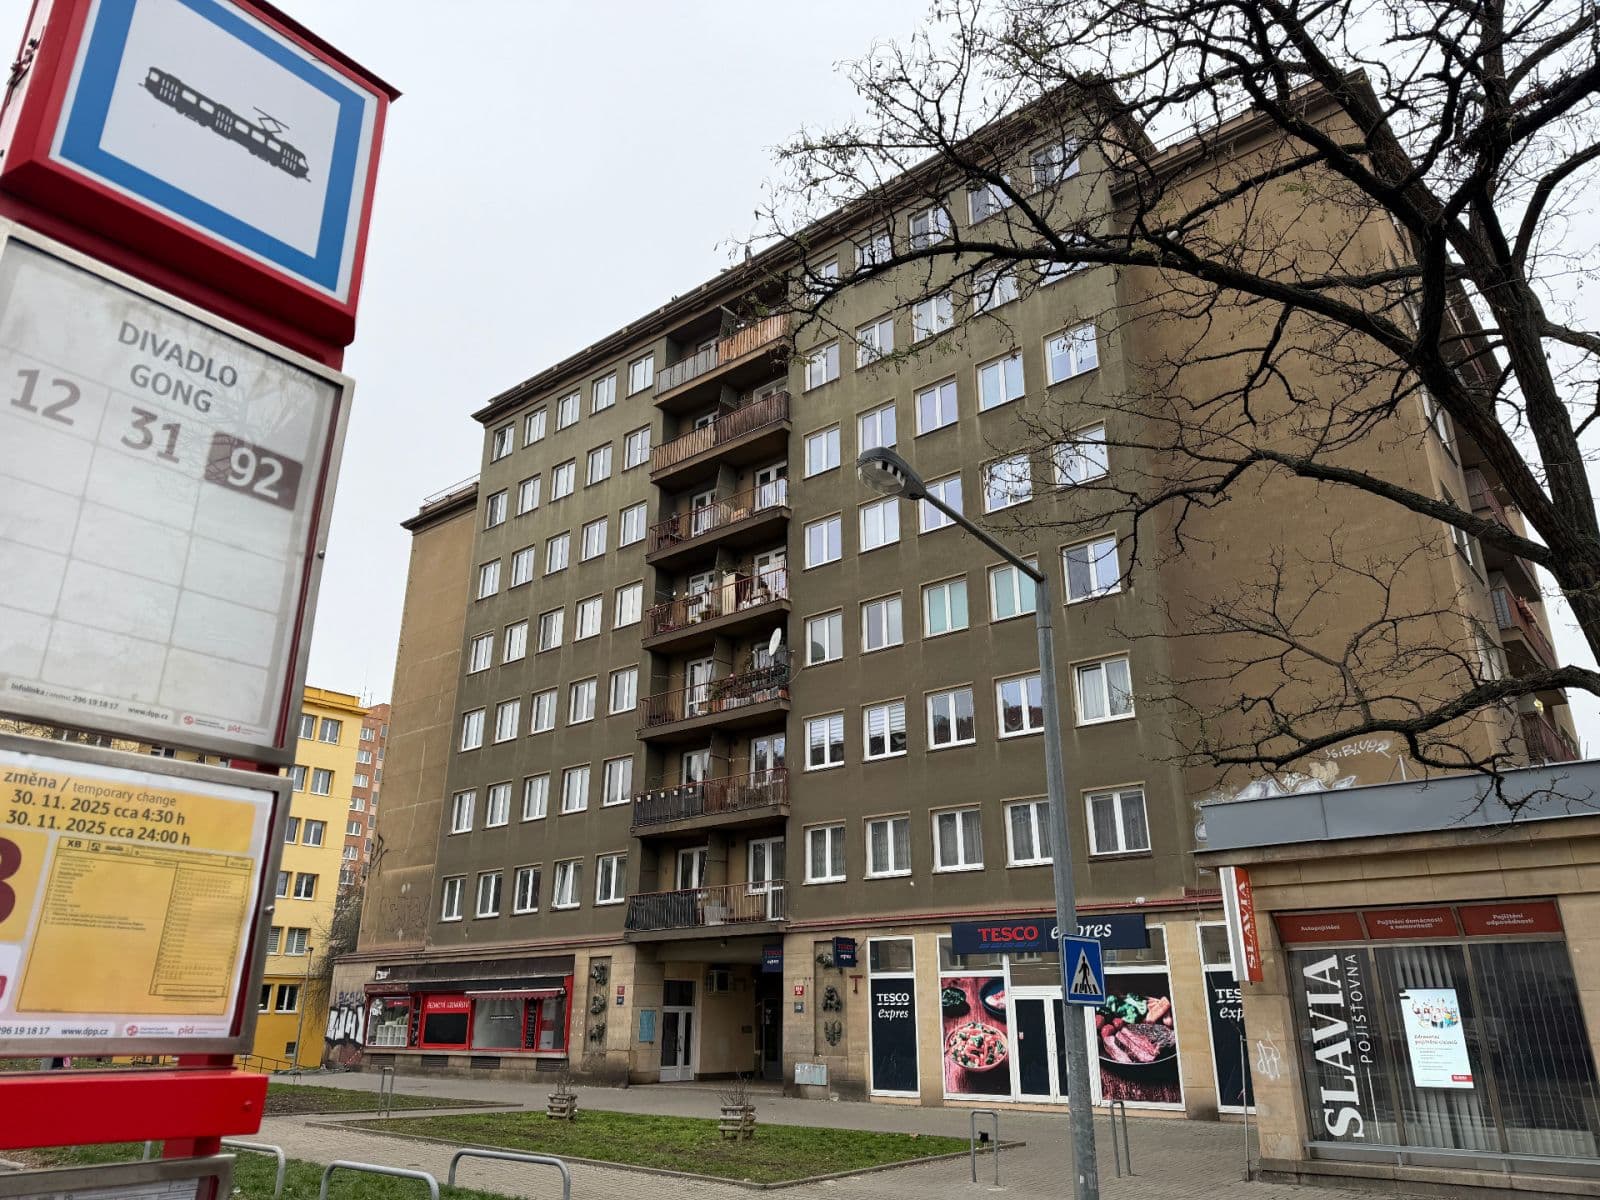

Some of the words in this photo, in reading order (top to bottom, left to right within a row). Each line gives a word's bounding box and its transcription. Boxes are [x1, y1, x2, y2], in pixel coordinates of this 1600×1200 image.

[117, 320, 238, 388] DIVADLO
[10, 369, 81, 426] 12
[130, 363, 214, 413] GONG
[121, 405, 183, 464] 31
[228, 446, 284, 500] 92
[73, 695, 87, 704] 296
[88, 698, 97, 706] 19
[110, 702, 119, 710] 17
[4, 771, 57, 790] změna
[60, 777, 70, 792] /
[73, 782, 134, 802] temporary
[136, 791, 177, 808] change
[11, 789, 36, 806] 30.
[42, 794, 65, 810] 11.
[70, 797, 111, 816] 2025
[114, 806, 138, 820] cca
[142, 807, 174, 824] 4:30
[176, 812, 186, 826] h
[6, 809, 31, 826] 30.
[36, 814, 61, 830] 11.
[65, 817, 106, 835] 2025
[109, 825, 135, 839] cca
[137, 827, 179, 844] 24:00
[181, 832, 191, 845] h
[977, 925, 1038, 943] TESCO
[1239, 881, 1256, 969] SLAVIA
[876, 992, 910, 1002] TESCO
[1215, 988, 1242, 999] TES
[1345, 954, 1374, 1064] POJIŠŤOVNA
[0, 1027, 13, 1035] 96
[14, 1027, 25, 1035] 19
[27, 1027, 37, 1035] 18
[39, 1027, 50, 1035] 17
[61, 1027, 108, 1036] www.dpp.cz
[178, 1026, 195, 1035] pid
[878, 1008, 909, 1022] expres
[1219, 1007, 1244, 1022] exp
[1303, 954, 1365, 1138] SLAVIA
